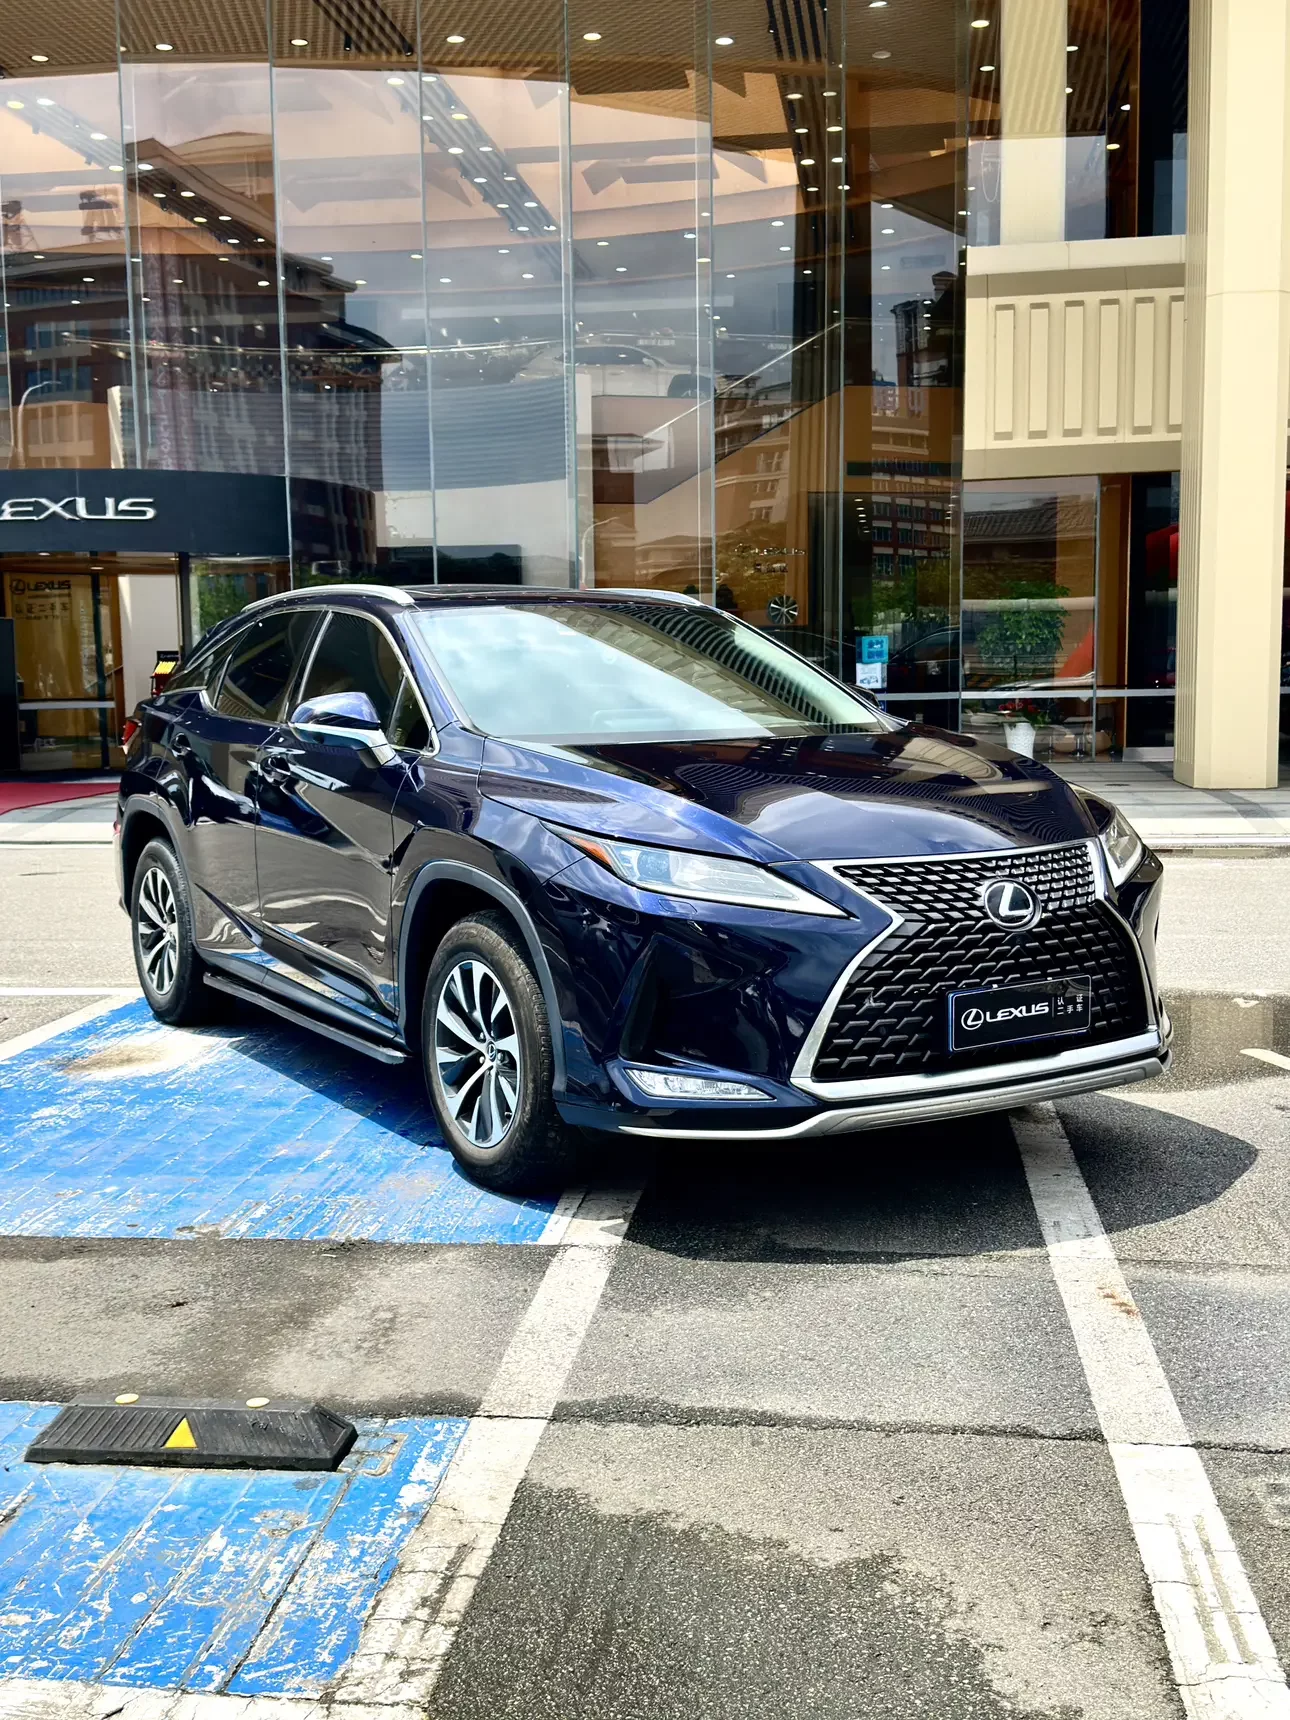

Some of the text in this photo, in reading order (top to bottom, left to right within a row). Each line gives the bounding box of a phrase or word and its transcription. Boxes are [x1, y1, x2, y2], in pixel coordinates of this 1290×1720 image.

[0, 497, 157, 521] EXUS
[27, 580, 71, 591] LEXUS
[986, 1002, 1049, 1022] LEXUS
[1056, 1003, 1084, 1015] 二手车
